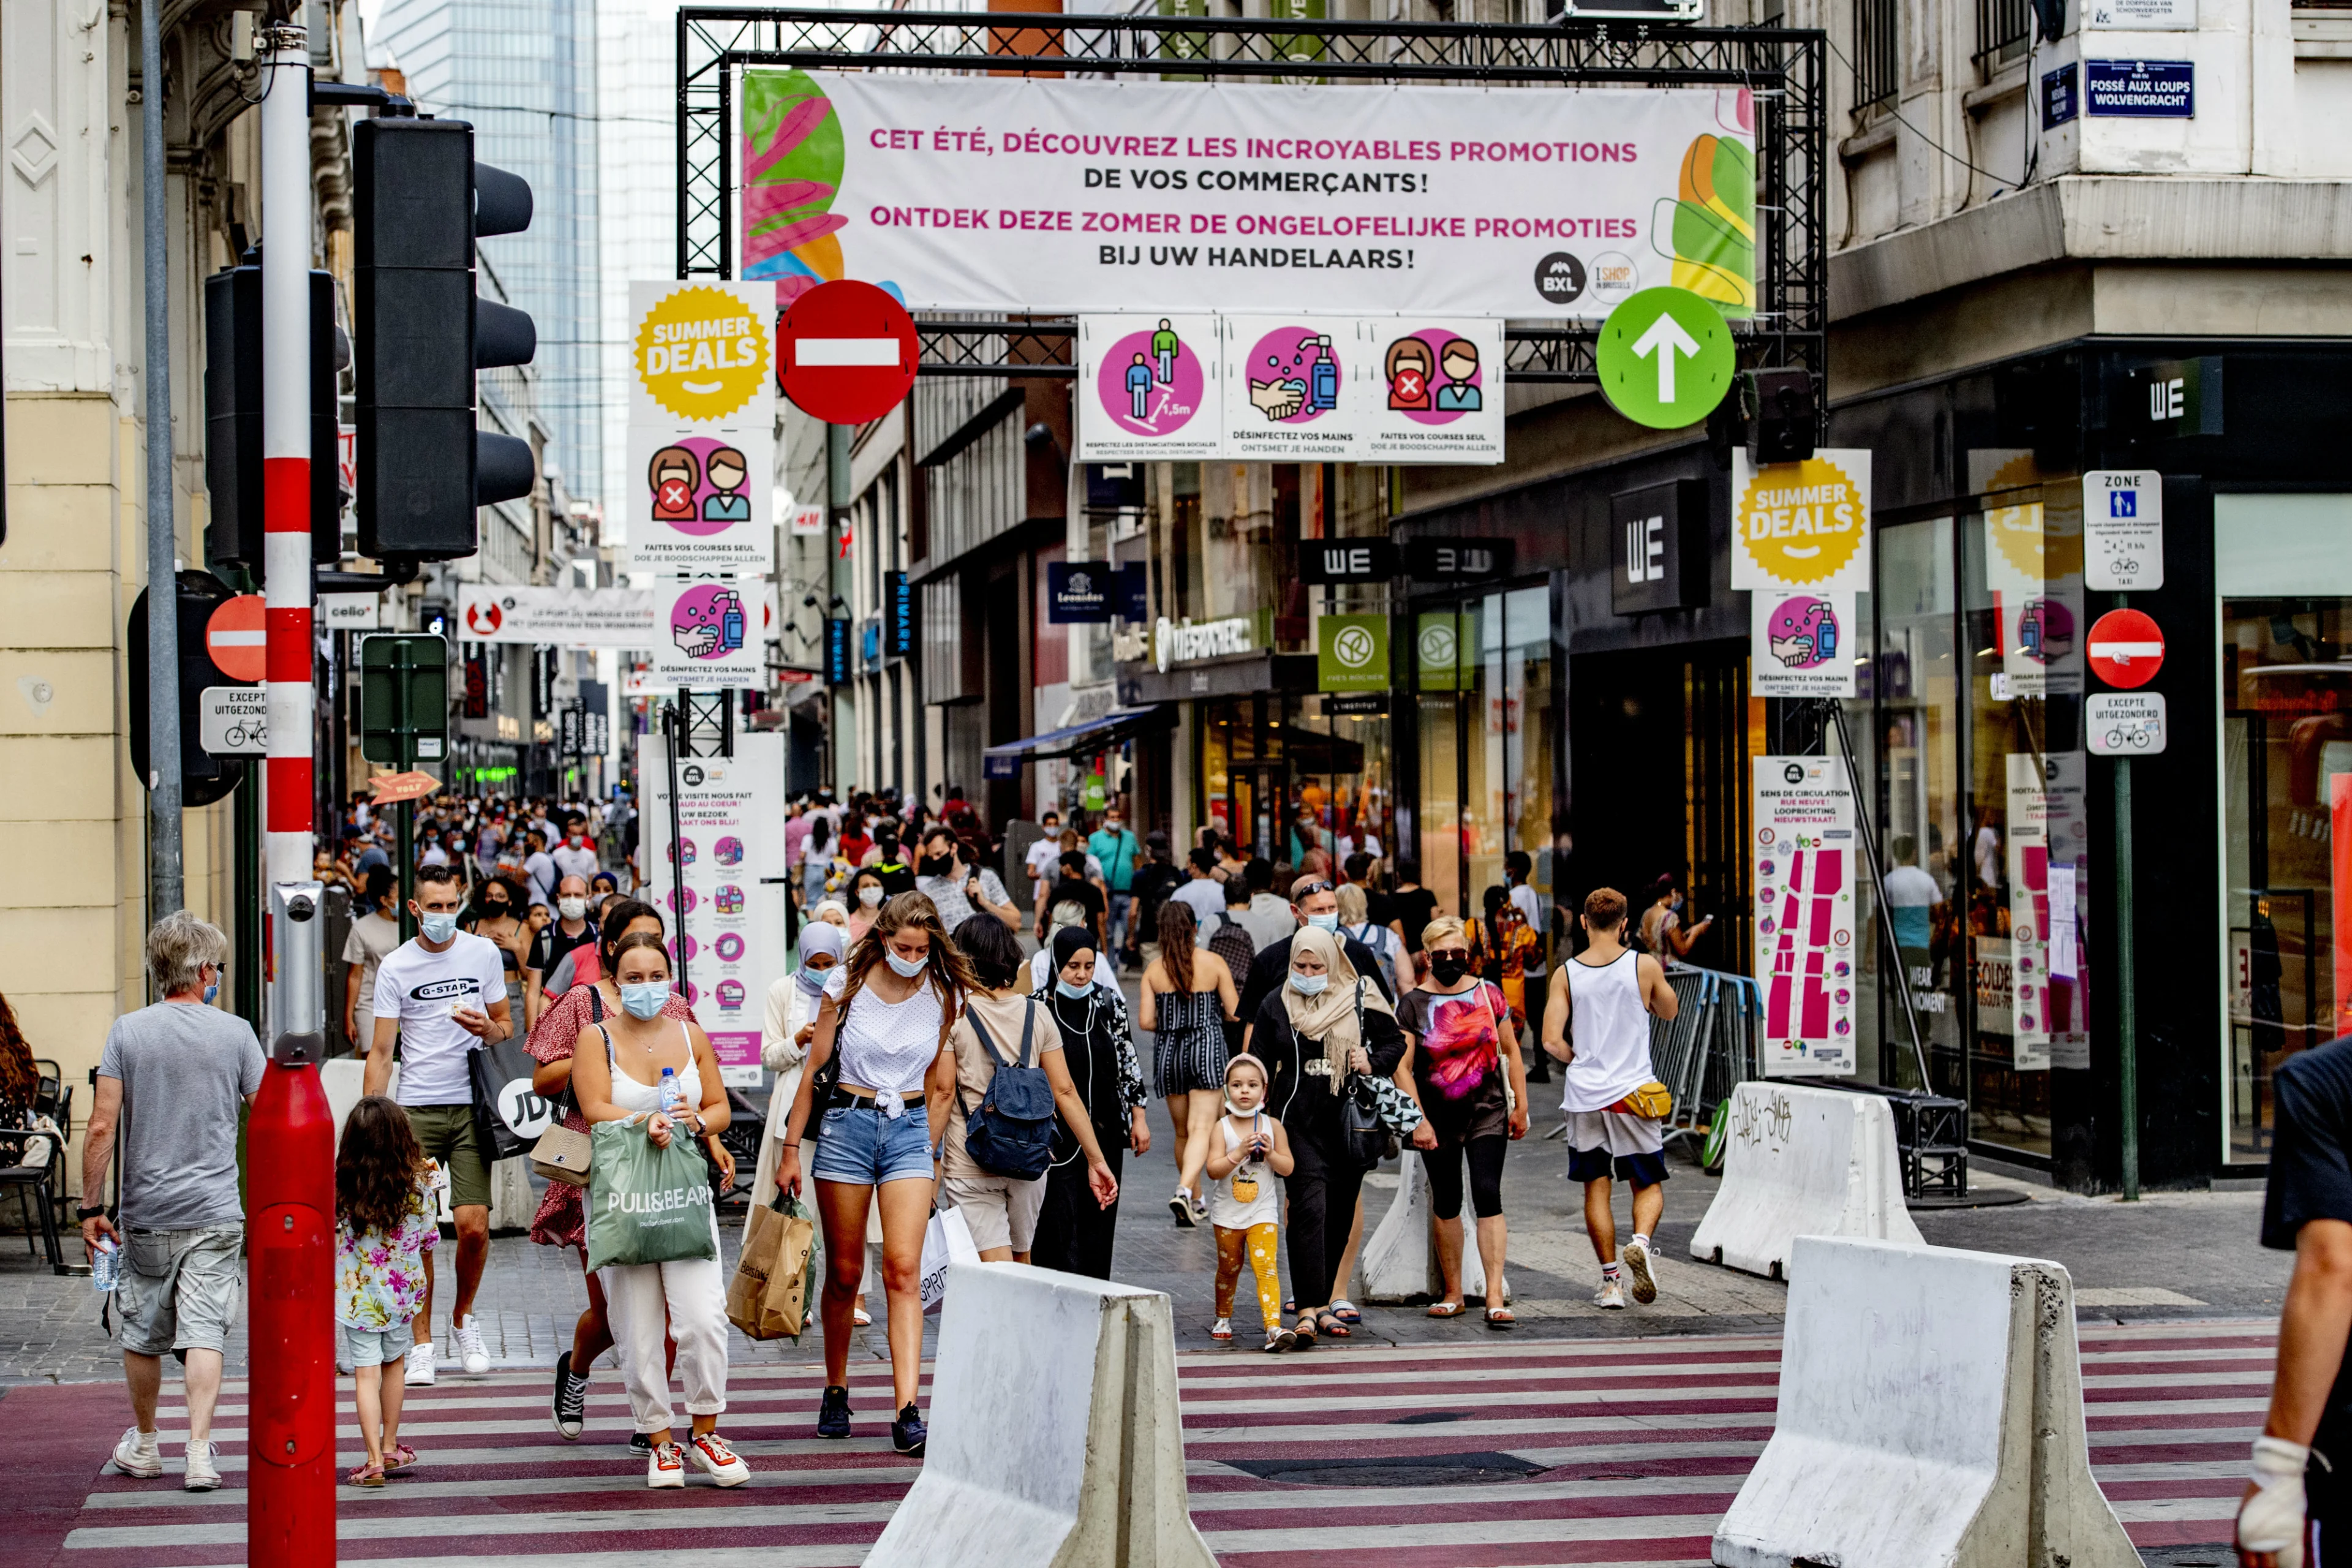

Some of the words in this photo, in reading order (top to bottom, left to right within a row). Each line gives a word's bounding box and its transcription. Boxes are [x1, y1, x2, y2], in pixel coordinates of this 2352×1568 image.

[2090, 78, 2125, 92] FOSSÉ
[2128, 81, 2152, 92] AUX
[2155, 81, 2190, 93] LOUPS
[2095, 94, 2187, 107] WOLVENGRACHT
[870, 129, 924, 149] CET
[933, 126, 994, 156] ÉTÉ,
[1003, 128, 1178, 157] DÉCOUVREZ
[1188, 137, 1237, 158] LES
[1247, 138, 1441, 162] INCROYABLES
[1450, 141, 1637, 163] PROMOTIONS
[1085, 168, 1121, 188] DE
[1131, 169, 1187, 190] VOS
[870, 206, 989, 230] ONTDEK
[999, 210, 1072, 231] DEZE
[1082, 213, 1181, 233] ZOMER
[1190, 214, 1227, 234] DE
[1237, 214, 1466, 238] ONGELOFELIJKE
[1474, 217, 1637, 239] PROMOTIES
[1099, 246, 1140, 266] BIJ
[1150, 247, 1199, 266] UW
[1602, 266, 1630, 281] SHOP
[1543, 276, 1578, 292] BXL
[1602, 281, 1630, 290] BRUSSELS
[653, 316, 751, 344] SUMMER
[646, 337, 758, 376] DEALS
[2150, 377, 2184, 421] WE
[1163, 404, 1191, 416] 1,5m
[1233, 431, 1298, 440] DÉSINFECTEZ
[1242, 444, 1288, 453] ONTSMET
[1291, 445, 1300, 453] JE
[1303, 445, 1344, 454] HANDEN
[1400, 443, 1464, 451] BOODSCHAPPEN
[2105, 476, 2141, 488] ZONE
[1755, 483, 1847, 510] SUMMER
[1749, 503, 1853, 541] DEALS
[1627, 516, 1664, 584] WE
[1325, 548, 1371, 575] WE
[897, 573, 911, 652] PRIMARK
[1758, 673, 1807, 682] DÉSINFECTEZ
[2095, 709, 2158, 719] UITGEZONDERD
[396, 783, 421, 794] WOLF
[422, 982, 467, 995] G-STAR
[513, 1090, 547, 1128] JD
[608, 1185, 707, 1213] PULL&BEAR
[639, 1216, 685, 1228] pullandbear.com
